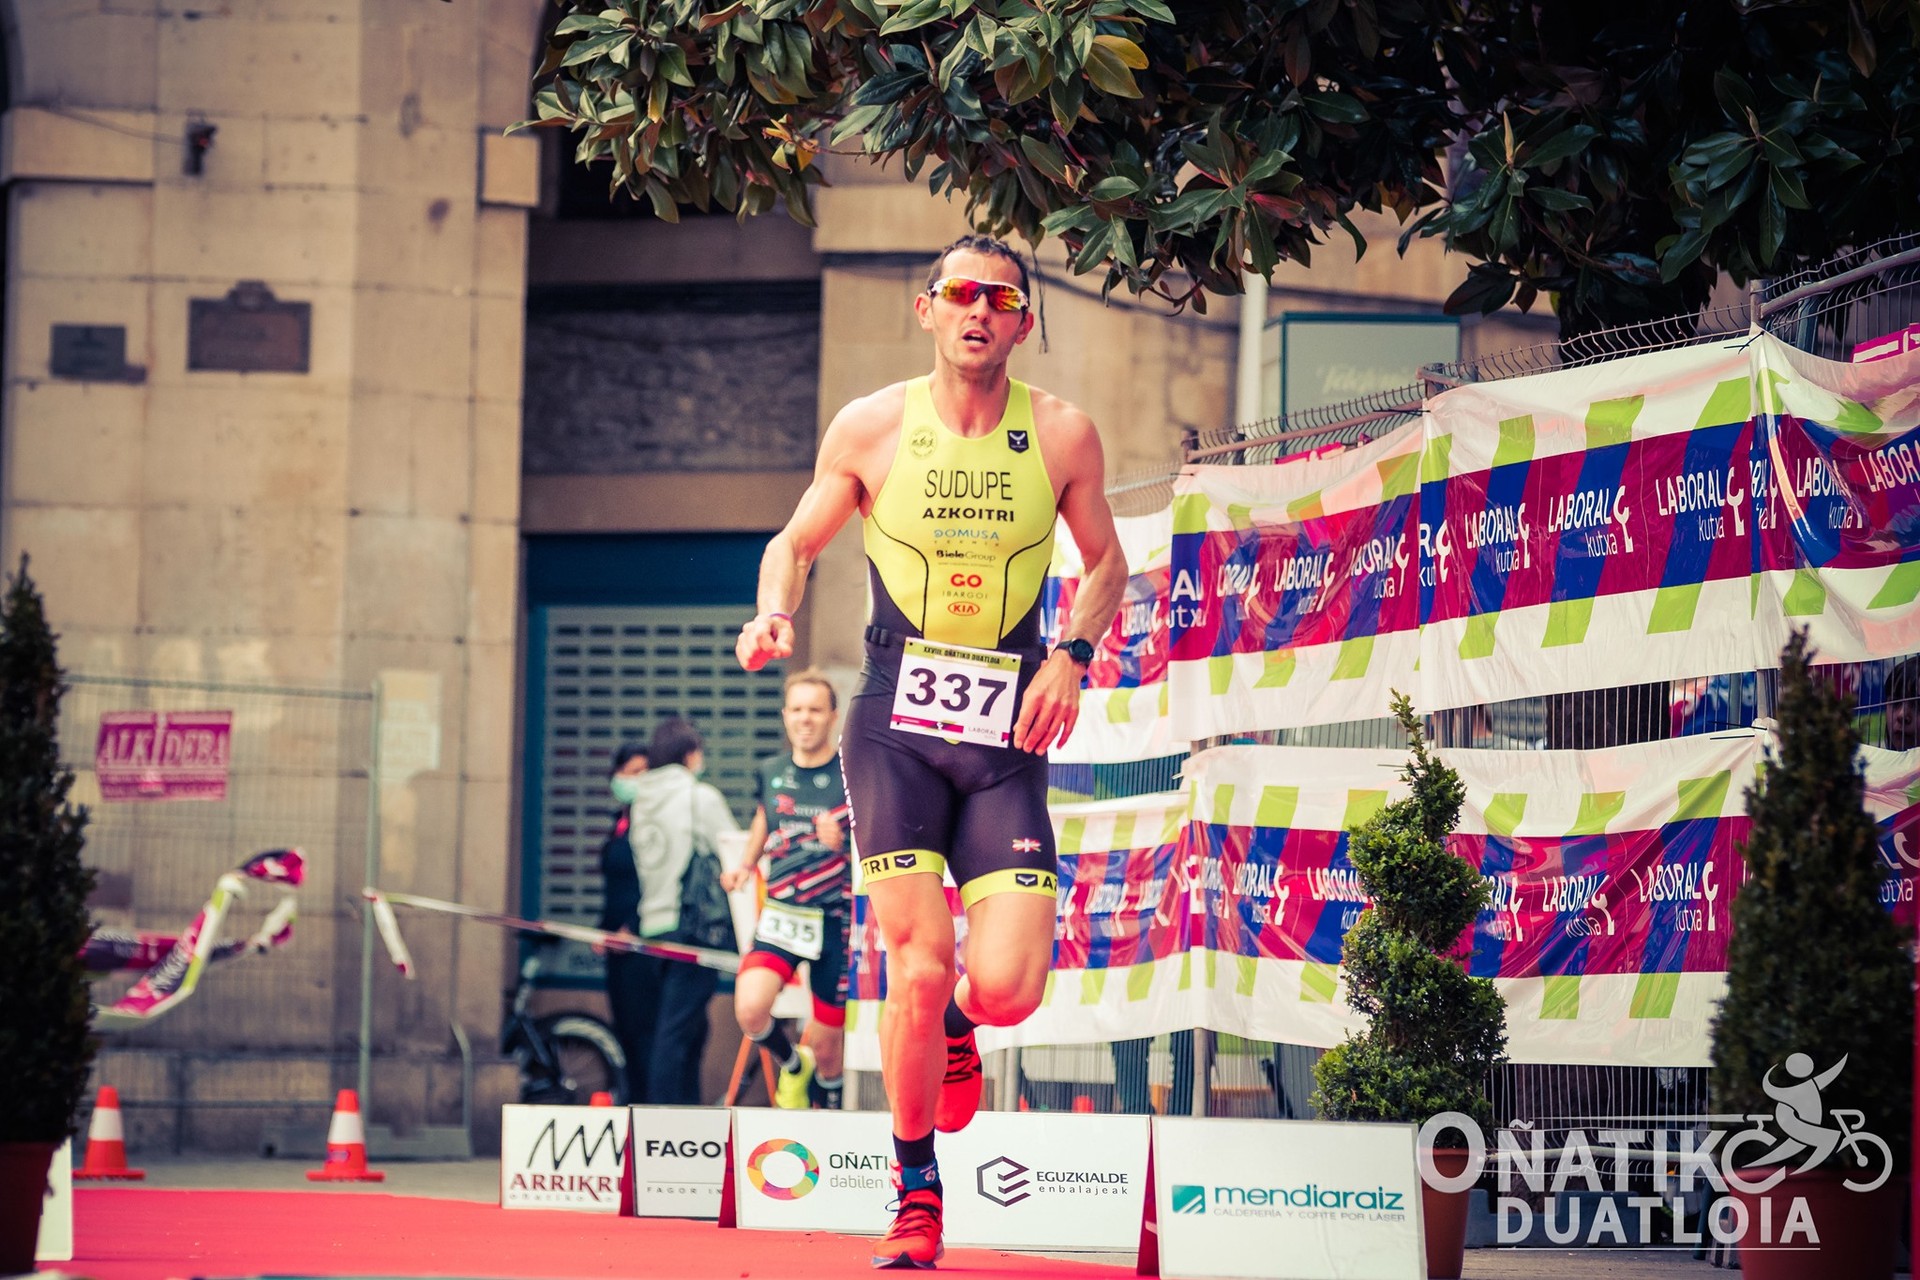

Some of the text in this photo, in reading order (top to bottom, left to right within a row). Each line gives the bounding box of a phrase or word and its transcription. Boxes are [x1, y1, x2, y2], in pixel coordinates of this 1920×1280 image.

[924, 469, 1013, 501] SUDUPE
[1655, 469, 1726, 516] LABORAL
[922, 507, 1014, 522] AZKOITRI
[1548, 488, 1613, 533] LABORAL
[1465, 505, 1519, 549] LABORAL
[1699, 511, 1725, 542] kutxa
[1585, 530, 1618, 558] kutxa
[1274, 553, 1324, 593] LABORAL
[1495, 548, 1520, 574] kutxa
[950, 573, 982, 588] GO
[953, 604, 975, 614] KIA
[905, 667, 1008, 717] 337
[1630, 862, 1702, 903] LABORAL
[645, 1140, 728, 1158] FAGO
[829, 1152, 888, 1170] OÑATI
[830, 1174, 884, 1189] dabilen
[1036, 1171, 1129, 1184] EGUZKIALDE
[1038, 1184, 1128, 1196] enbalajeak
[1214, 1184, 1405, 1211] mendiaraiz
[1298, 1211, 1337, 1220] CORTE
[1340, 1212, 1365, 1221] POR
